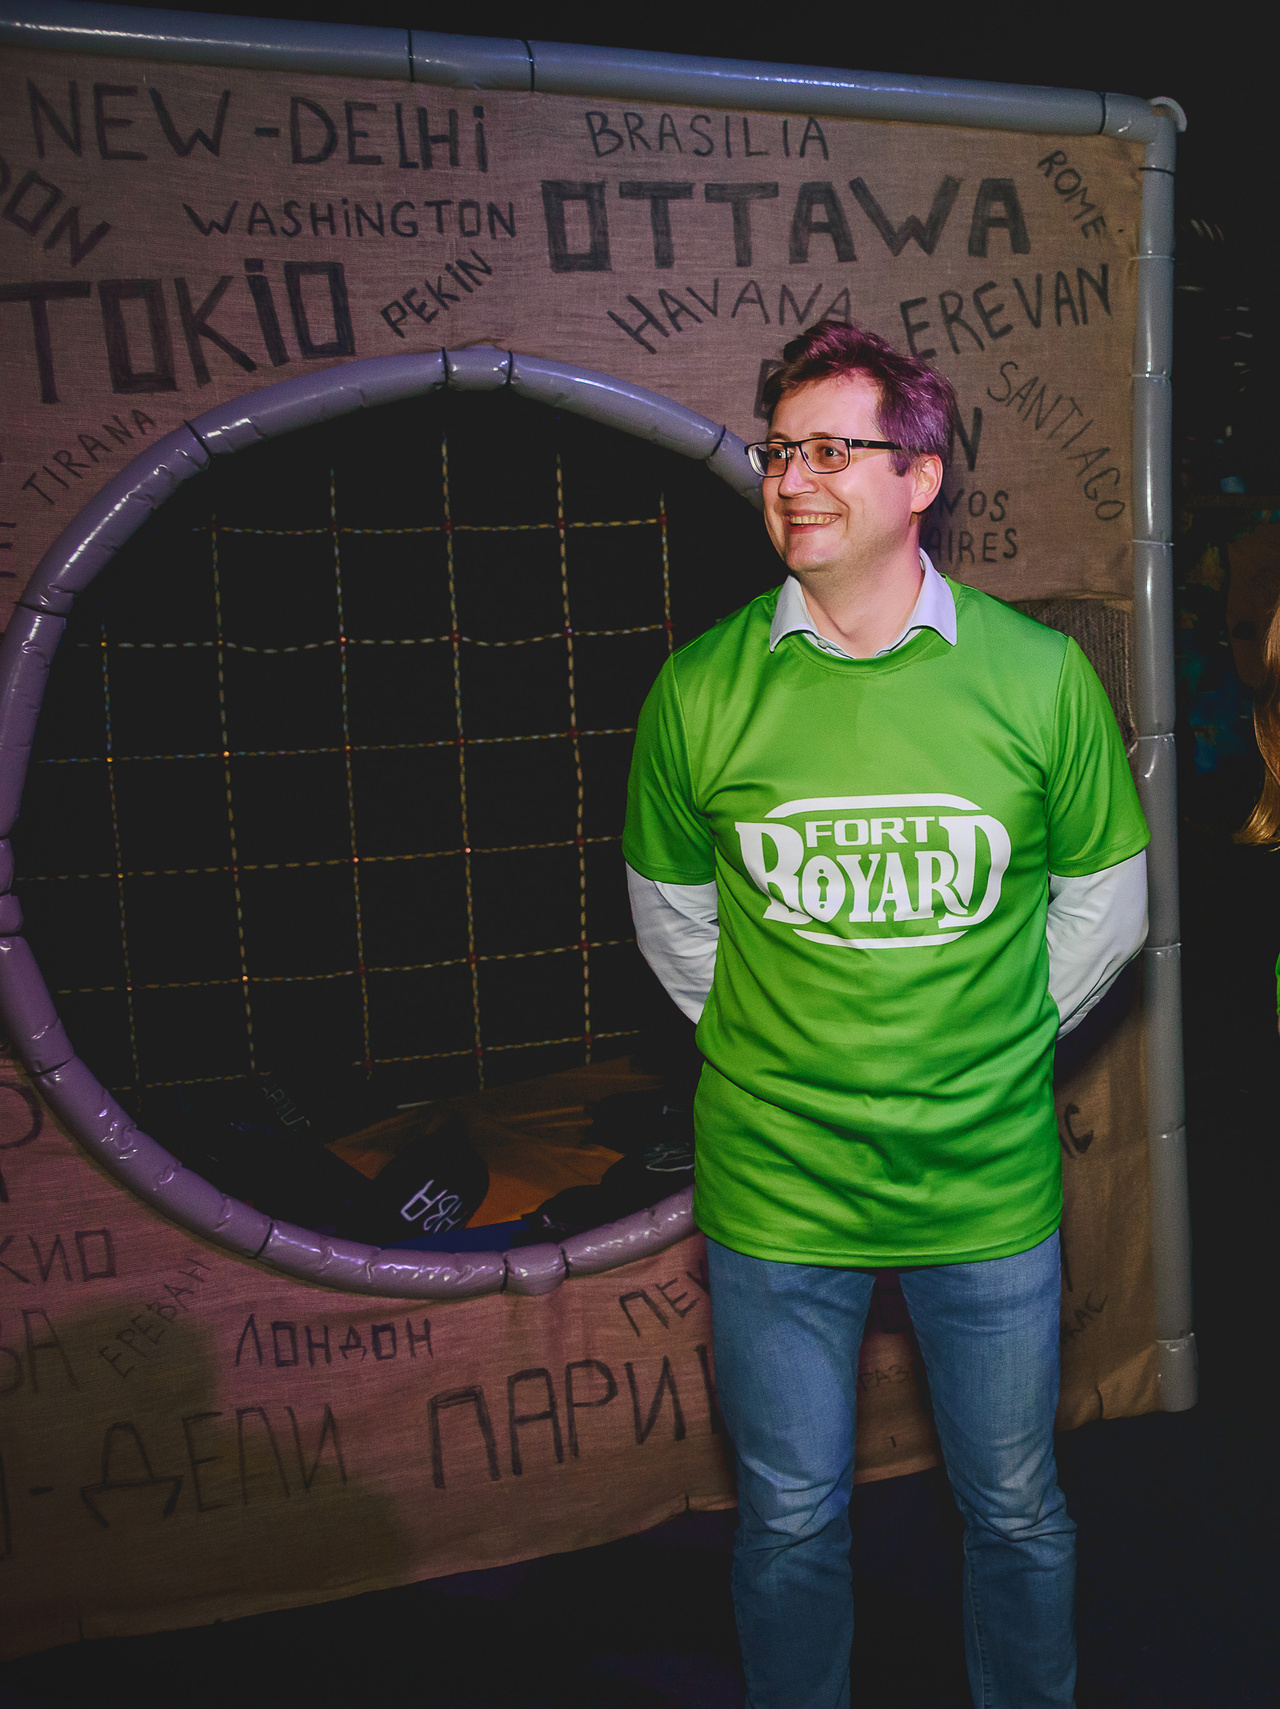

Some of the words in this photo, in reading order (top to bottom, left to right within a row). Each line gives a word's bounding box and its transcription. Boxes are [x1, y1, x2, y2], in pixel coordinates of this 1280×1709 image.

[585, 110, 830, 160] BRASILIA
[540, 175, 1032, 273] OTTAWA
[606, 276, 854, 355] HAVANA
[900, 263, 1112, 359] EREVAN
[21, 408, 156, 505] TIRANA
[986, 360, 1126, 521] SANTIAGO
[734, 814, 1013, 930] BOYARD
[805, 816, 936, 848] FORT
[99, 1257, 211, 1379] ЕРЕВАН
[235, 1313, 434, 1368] ЛОНДОН
